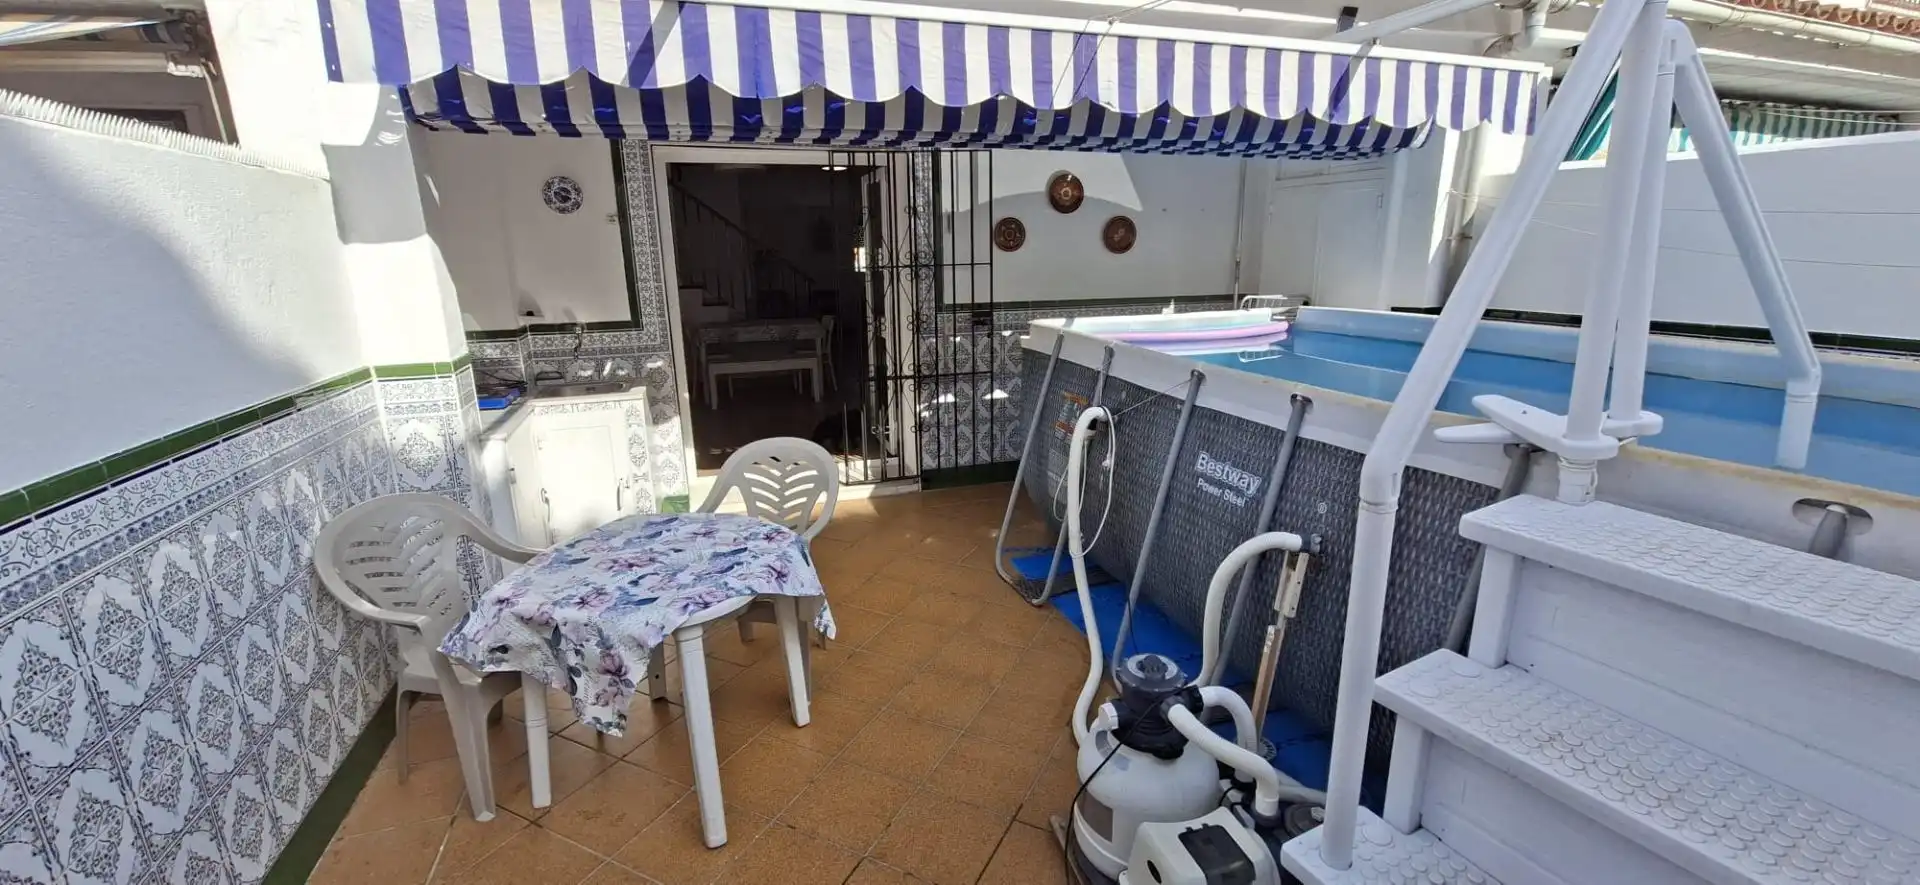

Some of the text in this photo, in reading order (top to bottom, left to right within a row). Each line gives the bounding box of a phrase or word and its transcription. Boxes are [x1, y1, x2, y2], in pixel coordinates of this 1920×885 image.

[1196, 452, 1261, 496] Bestway
[1197, 478, 1246, 507] Power Steel
